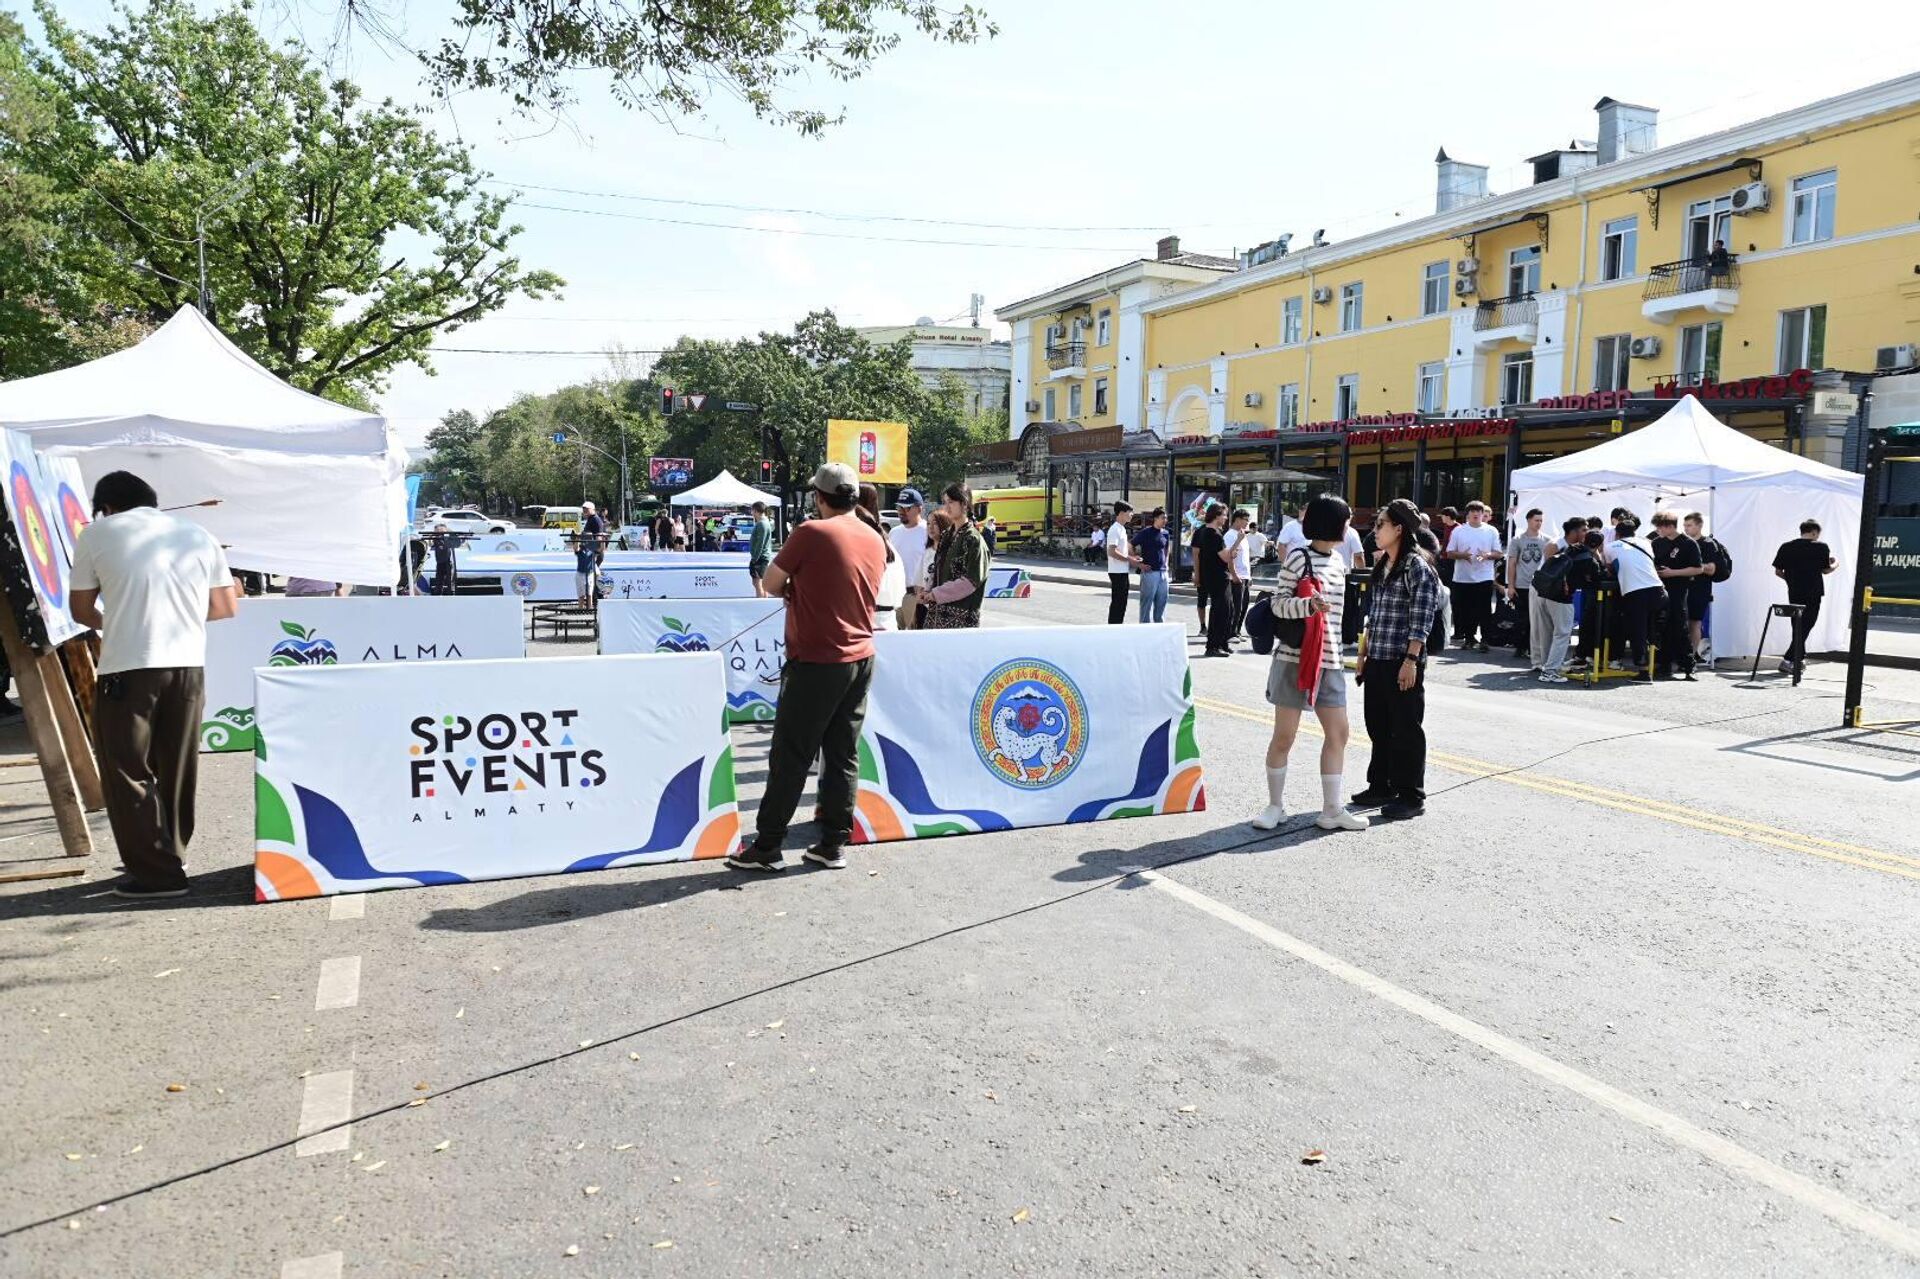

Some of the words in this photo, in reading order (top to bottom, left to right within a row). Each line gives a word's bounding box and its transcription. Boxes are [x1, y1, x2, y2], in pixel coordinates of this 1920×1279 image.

[1874, 536, 1899, 549] ТЫР.
[362, 643, 462, 661] ALMA
[730, 638, 786, 653] ALM
[730, 656, 786, 671] QAL
[410, 710, 579, 755] SPORT
[410, 750, 607, 798] EVENTS
[412, 801, 574, 822] ALMATY
